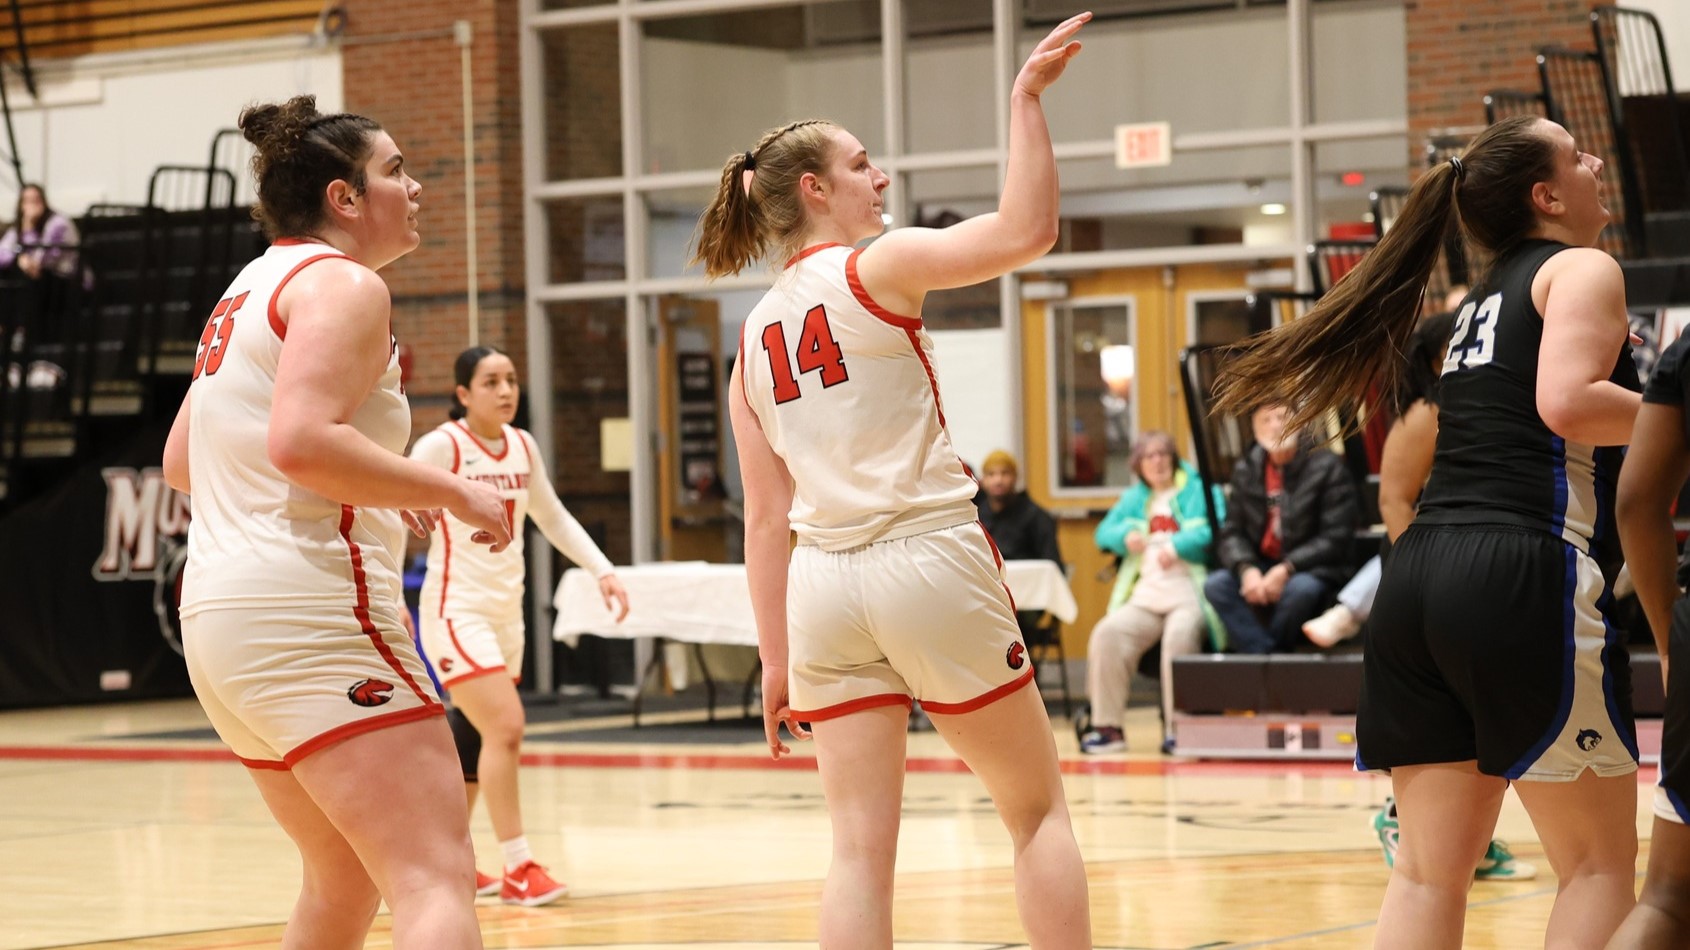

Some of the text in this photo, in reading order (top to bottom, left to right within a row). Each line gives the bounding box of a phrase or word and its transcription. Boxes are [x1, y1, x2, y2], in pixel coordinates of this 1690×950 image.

[192, 290, 251, 382] 55
[761, 303, 849, 405] 14
[1440, 290, 1503, 379] 23
